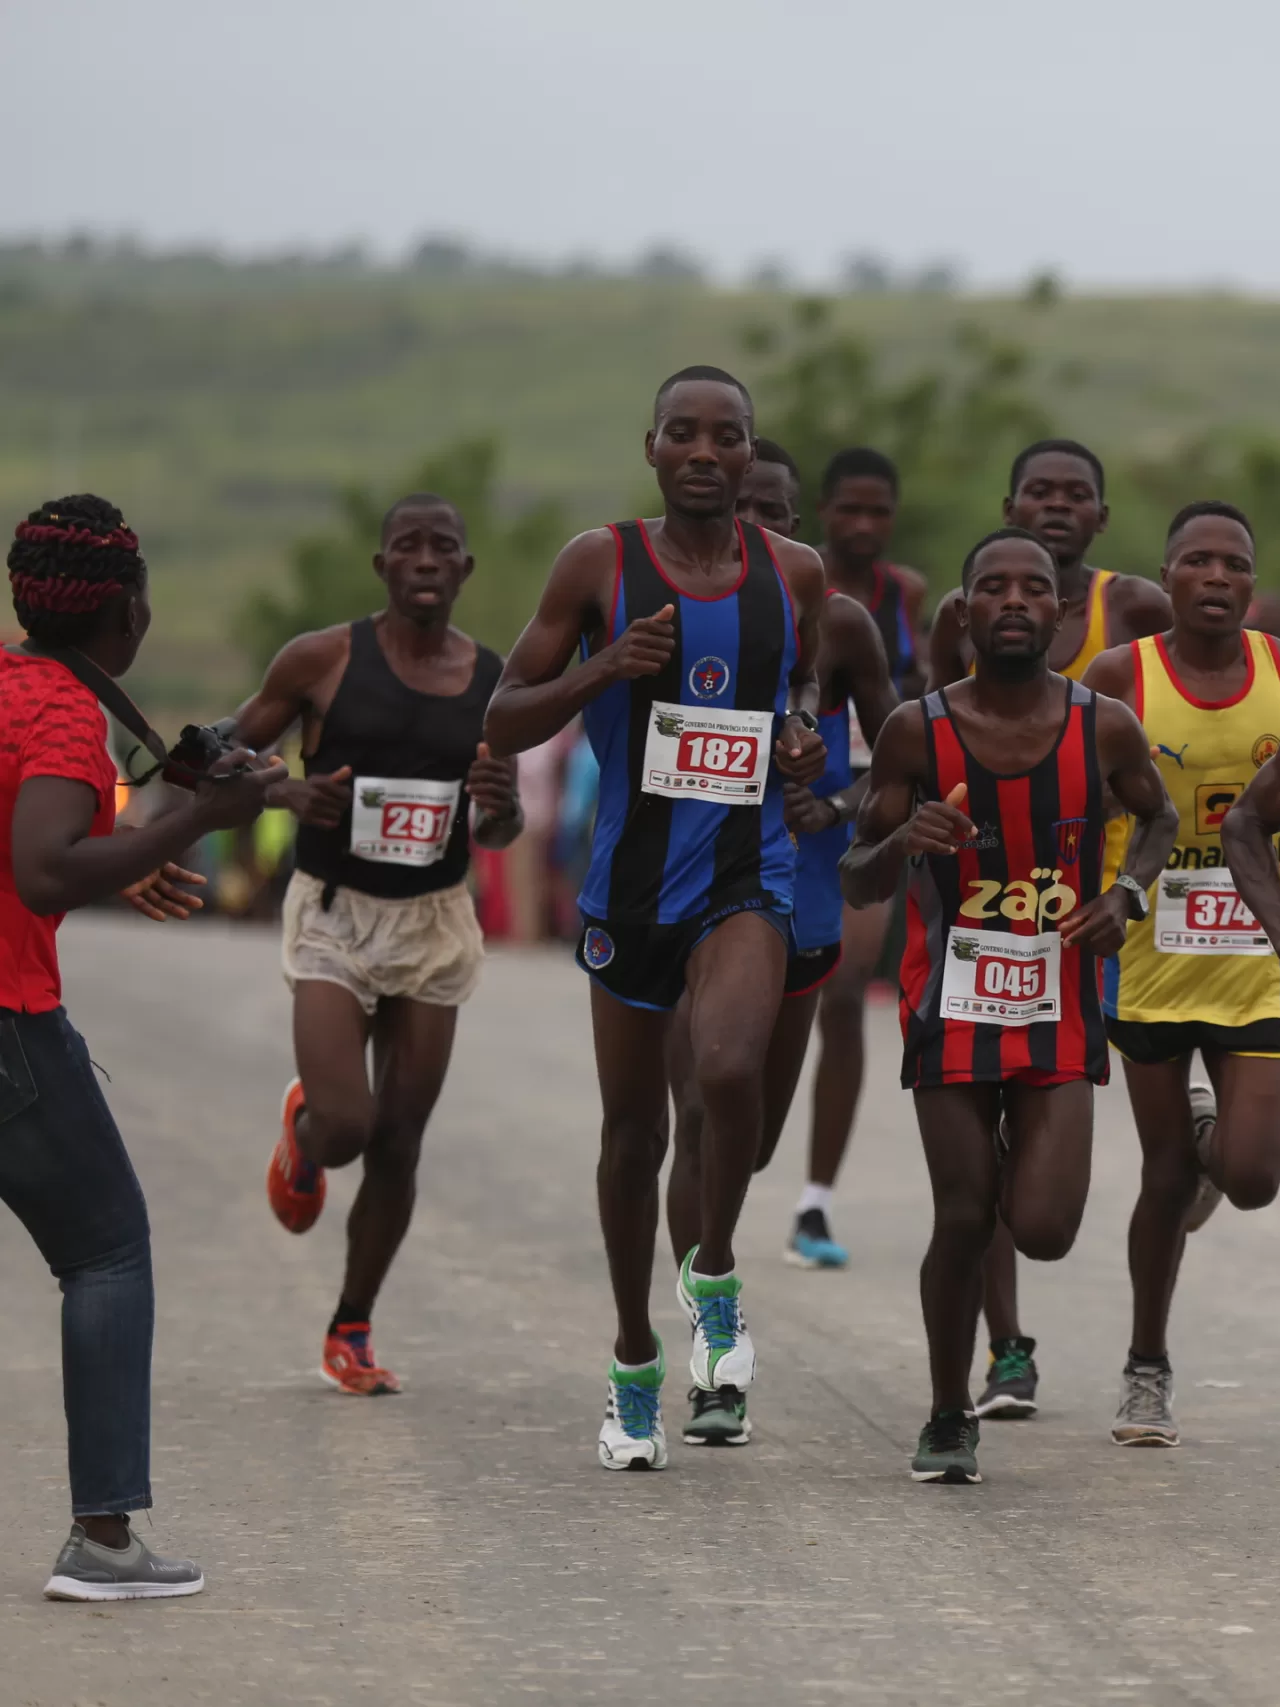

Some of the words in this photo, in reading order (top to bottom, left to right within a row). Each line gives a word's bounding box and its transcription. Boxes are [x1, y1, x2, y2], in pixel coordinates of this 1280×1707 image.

[684, 720, 707, 729] GOVERNO
[708, 722, 716, 730] DA
[742, 725, 749, 733] DO
[687, 736, 752, 773] 182
[386, 806, 447, 840] 291
[1194, 894, 1256, 927] 374
[980, 944, 1004, 954] GOVERNO
[984, 961, 1040, 997] 045
